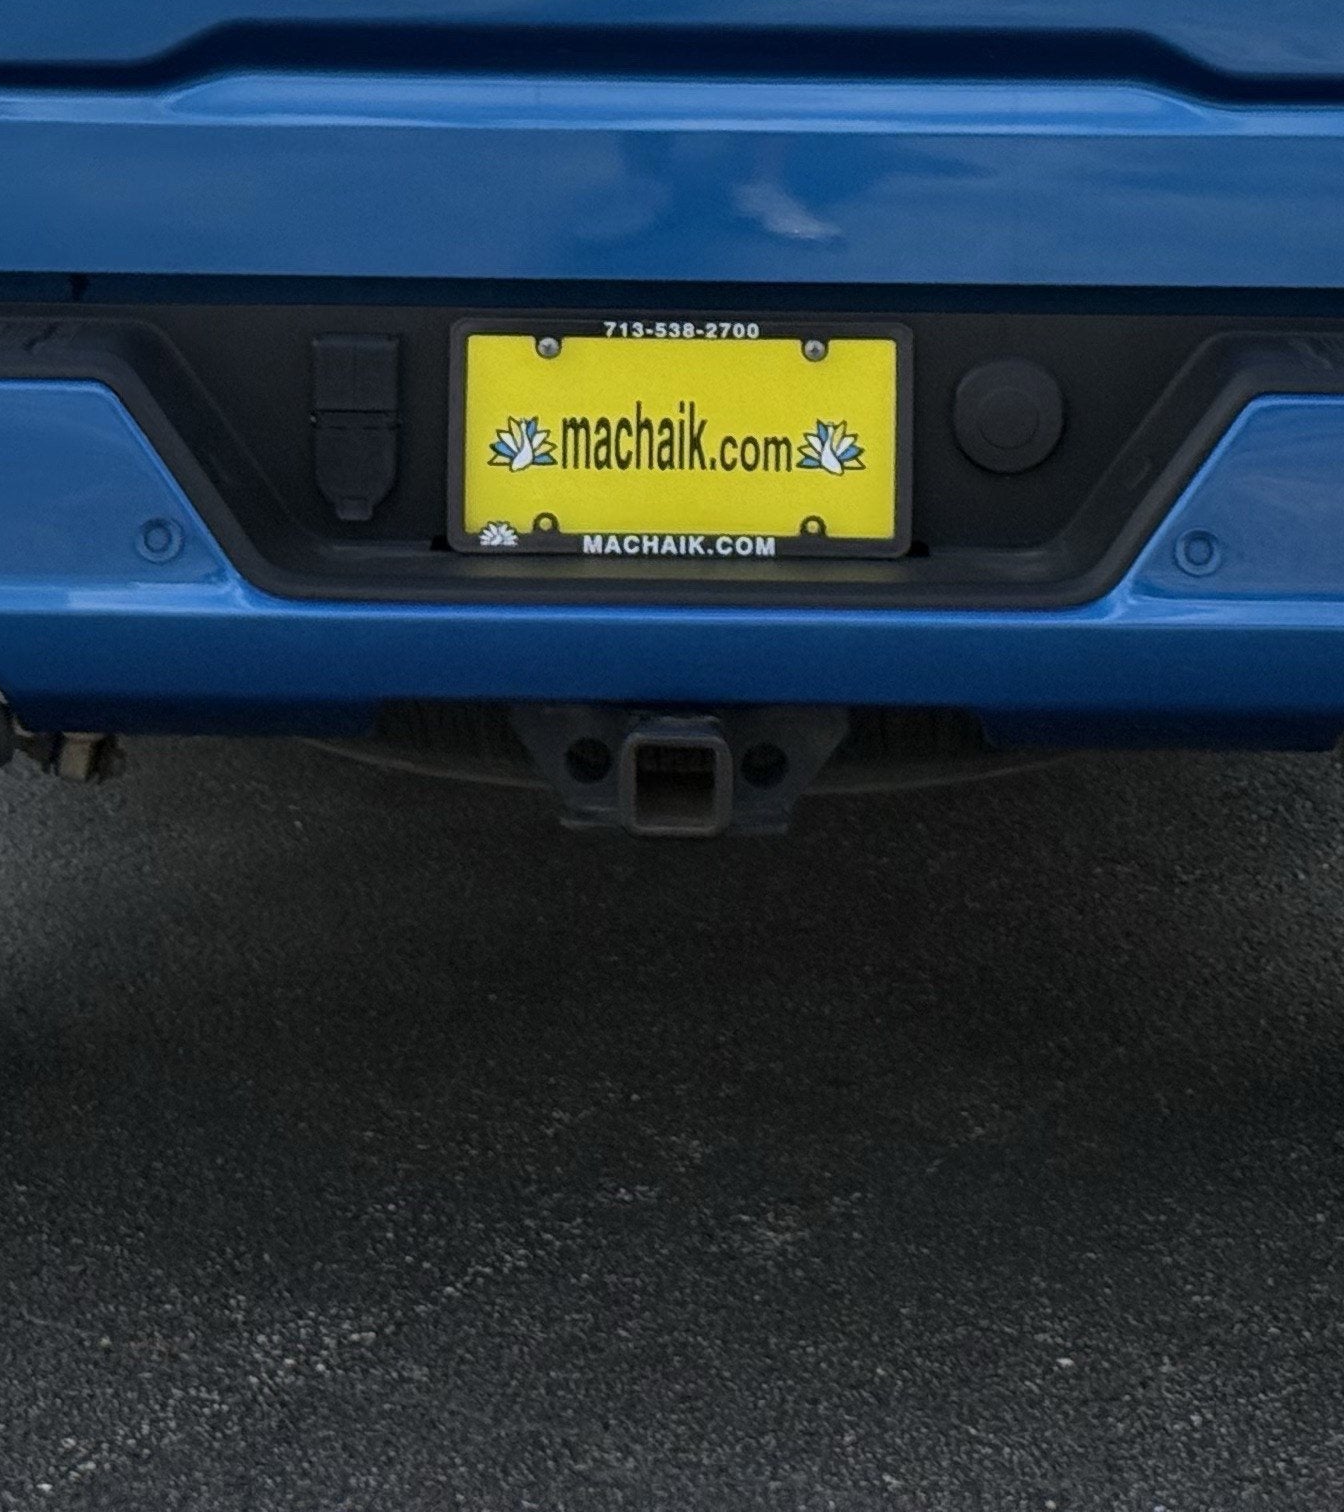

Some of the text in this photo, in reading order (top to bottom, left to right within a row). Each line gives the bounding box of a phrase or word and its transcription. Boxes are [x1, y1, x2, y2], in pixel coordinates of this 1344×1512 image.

[603, 321, 760, 339] 713-538-2700
[561, 400, 793, 472] machaik.com
[582, 533, 776, 557] MACHAIK.COM
